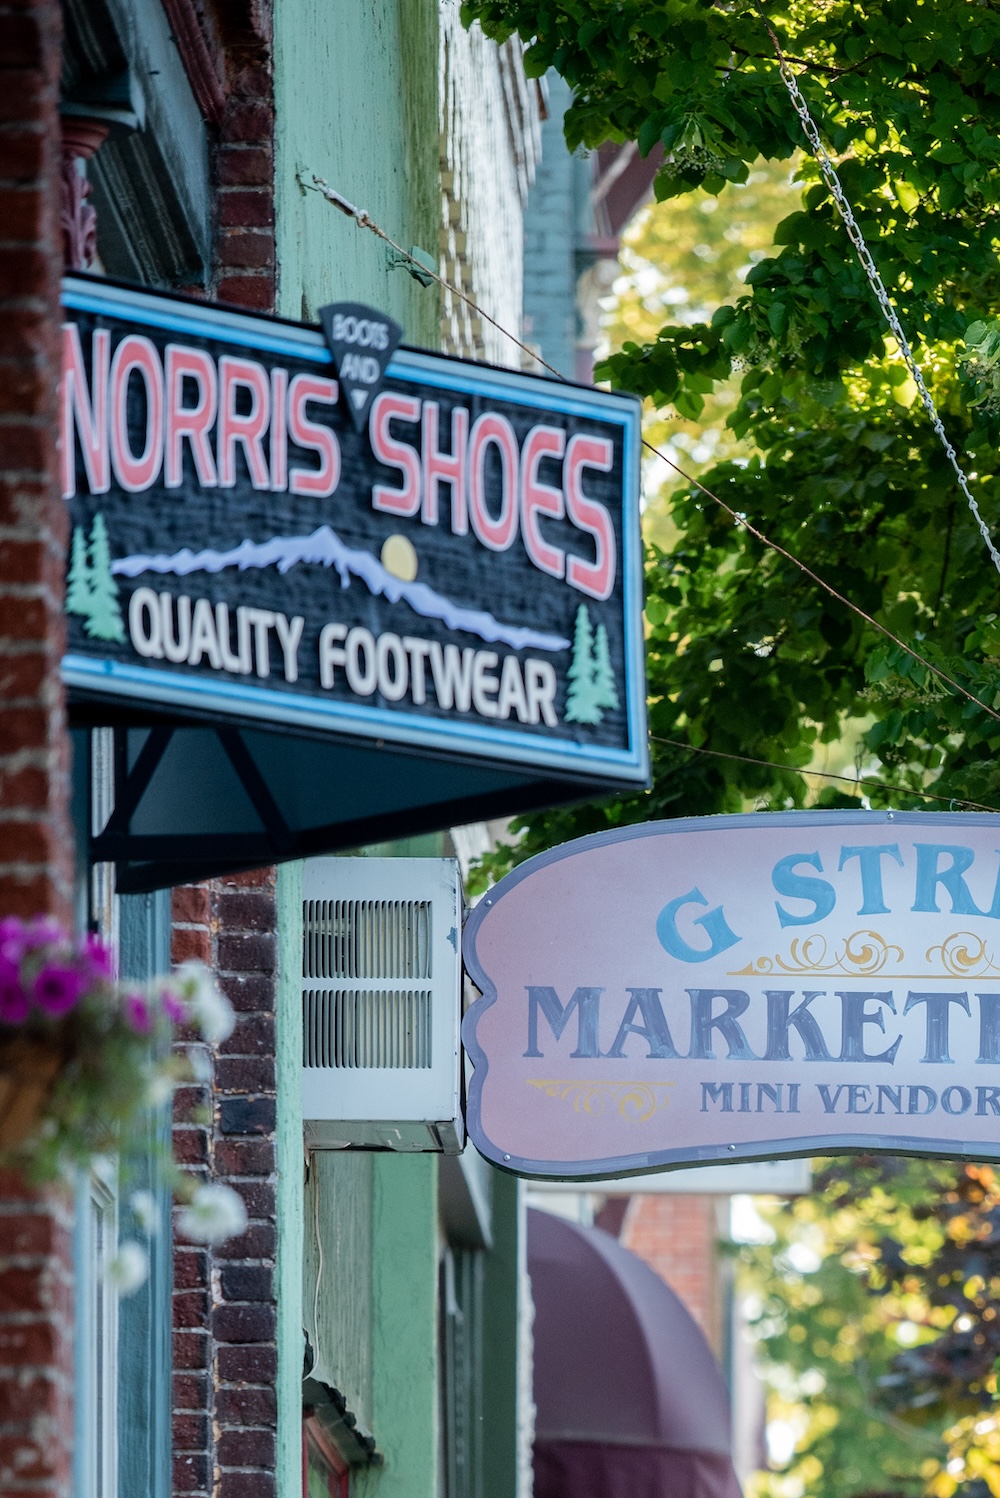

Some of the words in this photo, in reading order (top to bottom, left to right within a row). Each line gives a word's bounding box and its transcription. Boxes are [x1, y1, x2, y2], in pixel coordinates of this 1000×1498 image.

[332, 313, 390, 350] BOOTS
[339, 352, 381, 385] AND
[60, 321, 342, 500] NORRIS
[369, 390, 617, 601] SHOES
[128, 586, 305, 683] QUALITY
[318, 622, 560, 728] FOOTWEAR
[655, 885, 743, 963] G
[699, 1081, 801, 1114] MINI
